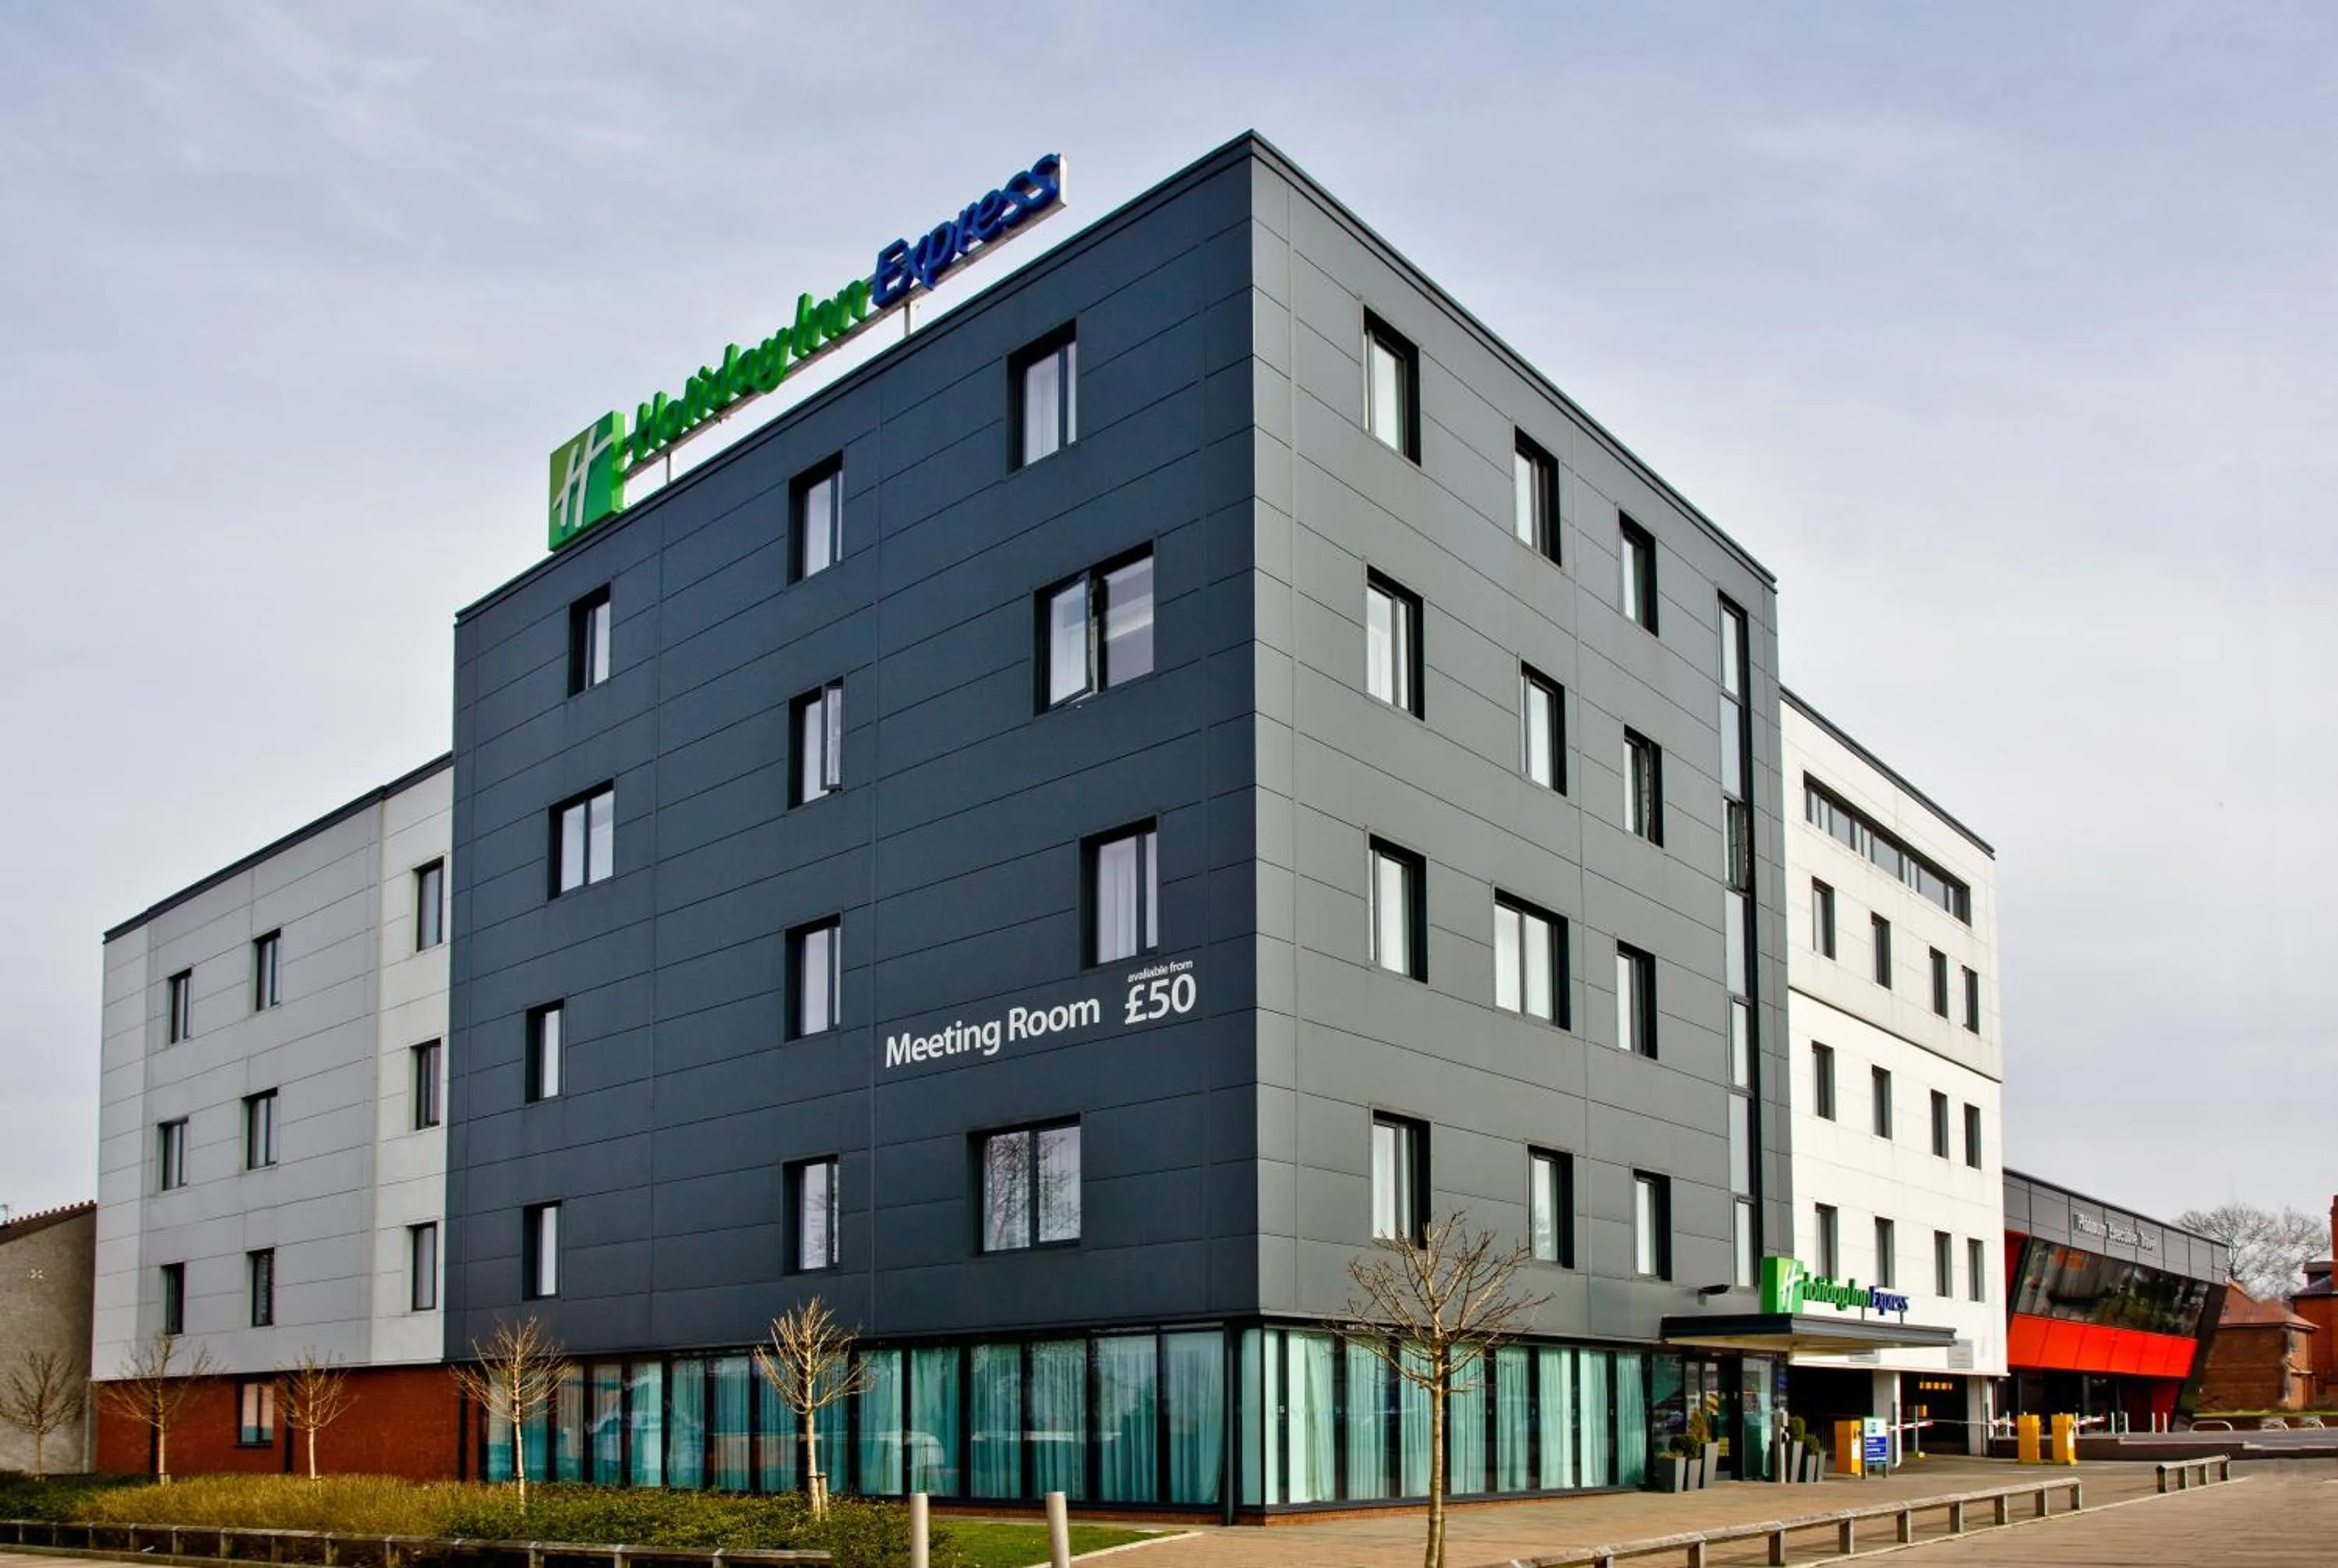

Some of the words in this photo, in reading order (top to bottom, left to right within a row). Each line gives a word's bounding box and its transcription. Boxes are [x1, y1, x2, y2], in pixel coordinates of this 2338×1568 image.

[632, 327, 792, 462] Holiday
[791, 278, 871, 360] Inn
[871, 153, 1061, 309] Express
[1170, 960, 1193, 973] from
[1125, 973, 1196, 1025] £50
[885, 1019, 1001, 1068] Meeting
[1008, 998, 1100, 1042] Room
[1869, 1285, 1909, 1315] Express
